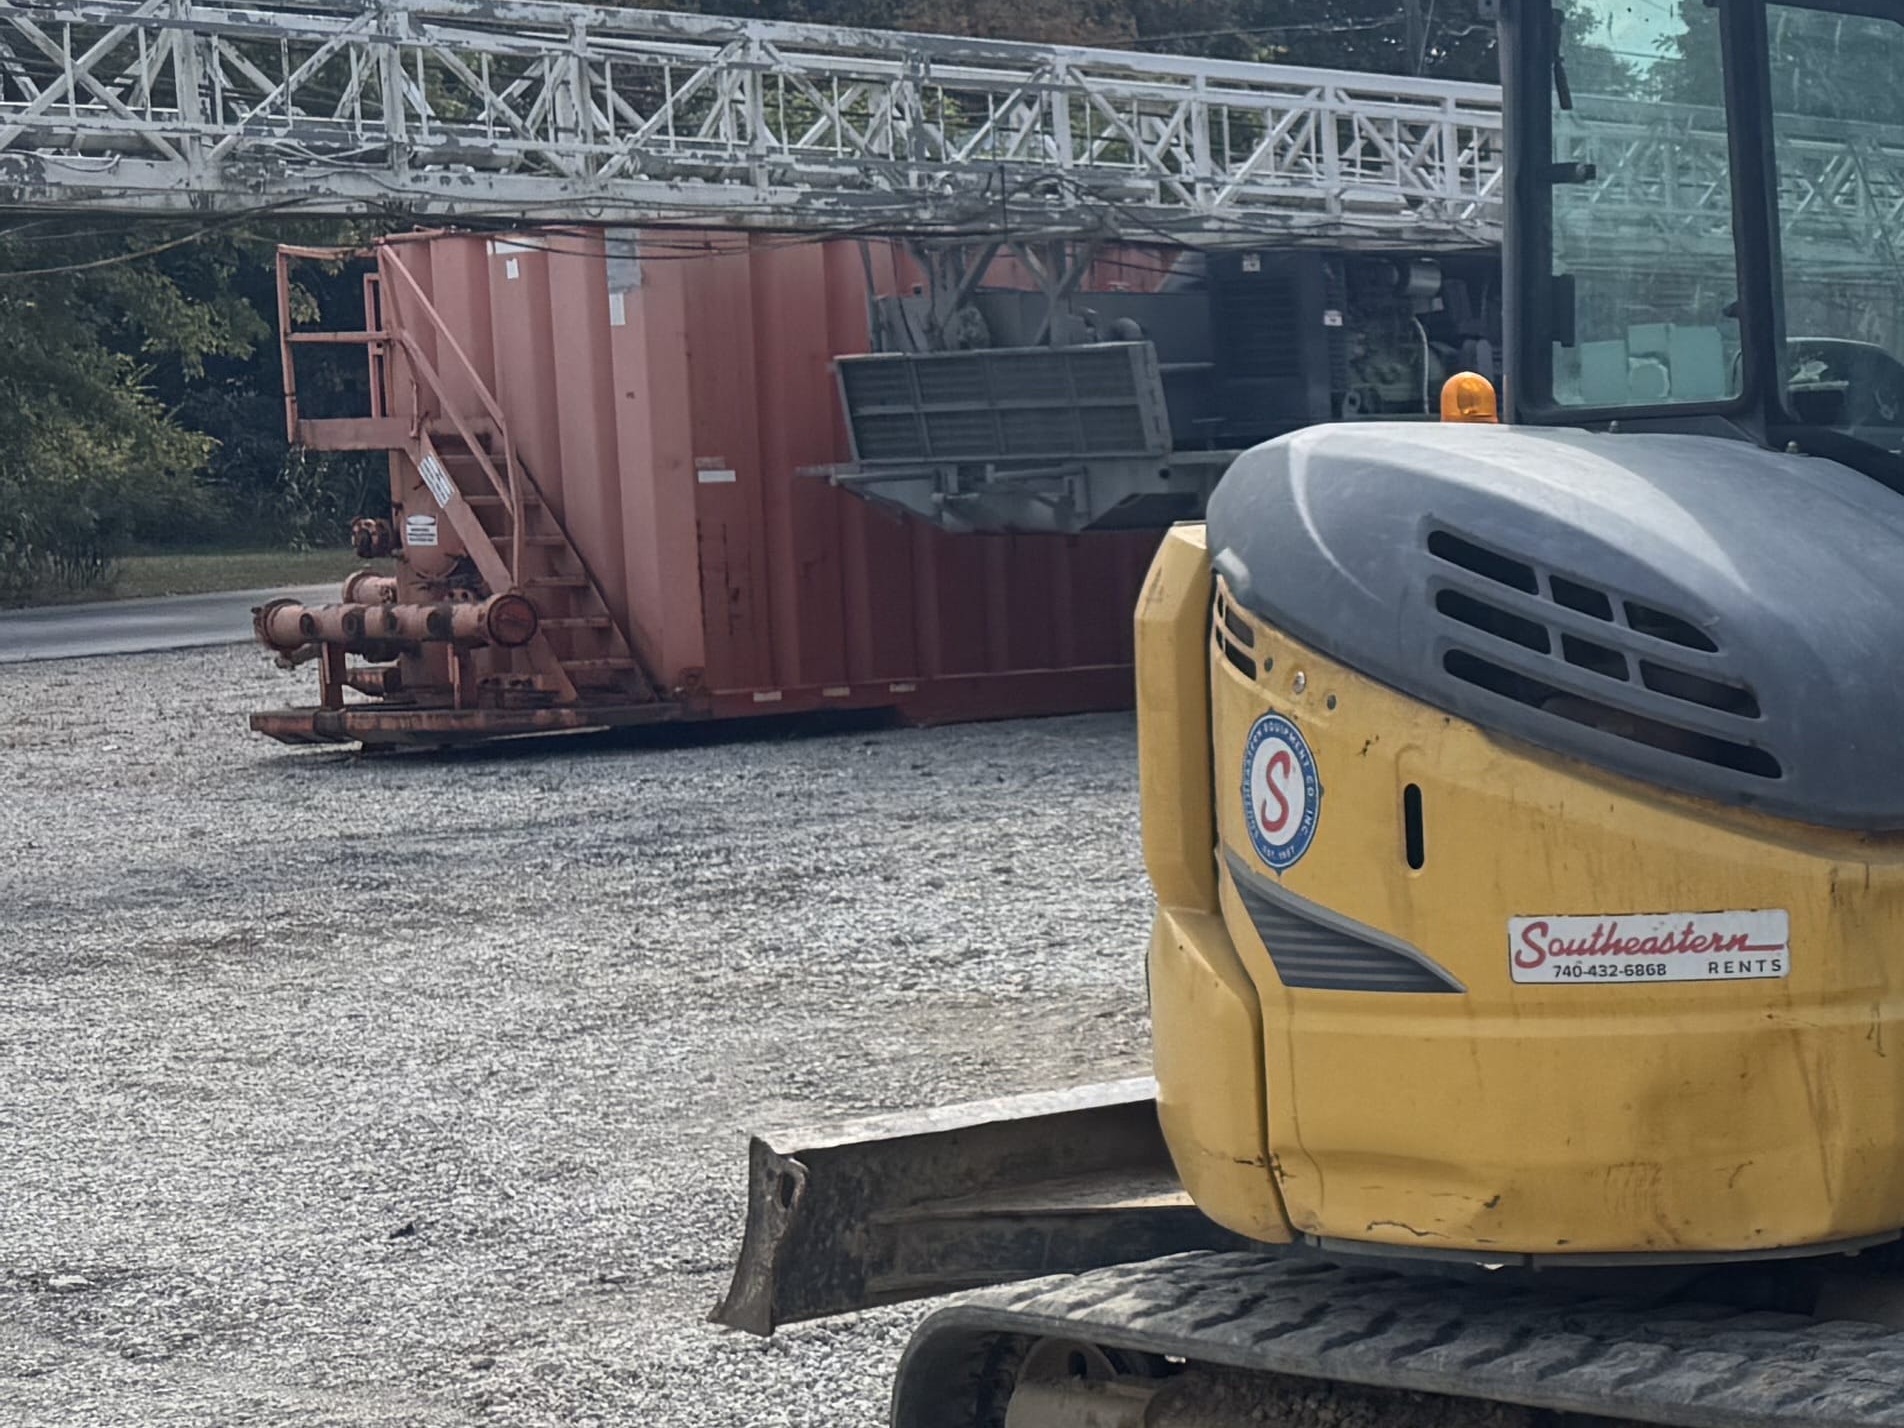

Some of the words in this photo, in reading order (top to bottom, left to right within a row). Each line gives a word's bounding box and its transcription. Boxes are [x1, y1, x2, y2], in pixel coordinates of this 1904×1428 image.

[1261, 750, 1291, 833] S
[1514, 920, 1784, 969] Southeastern
[1552, 963, 1667, 978] 740-432-6868
[1708, 959, 1783, 974] RENTS
